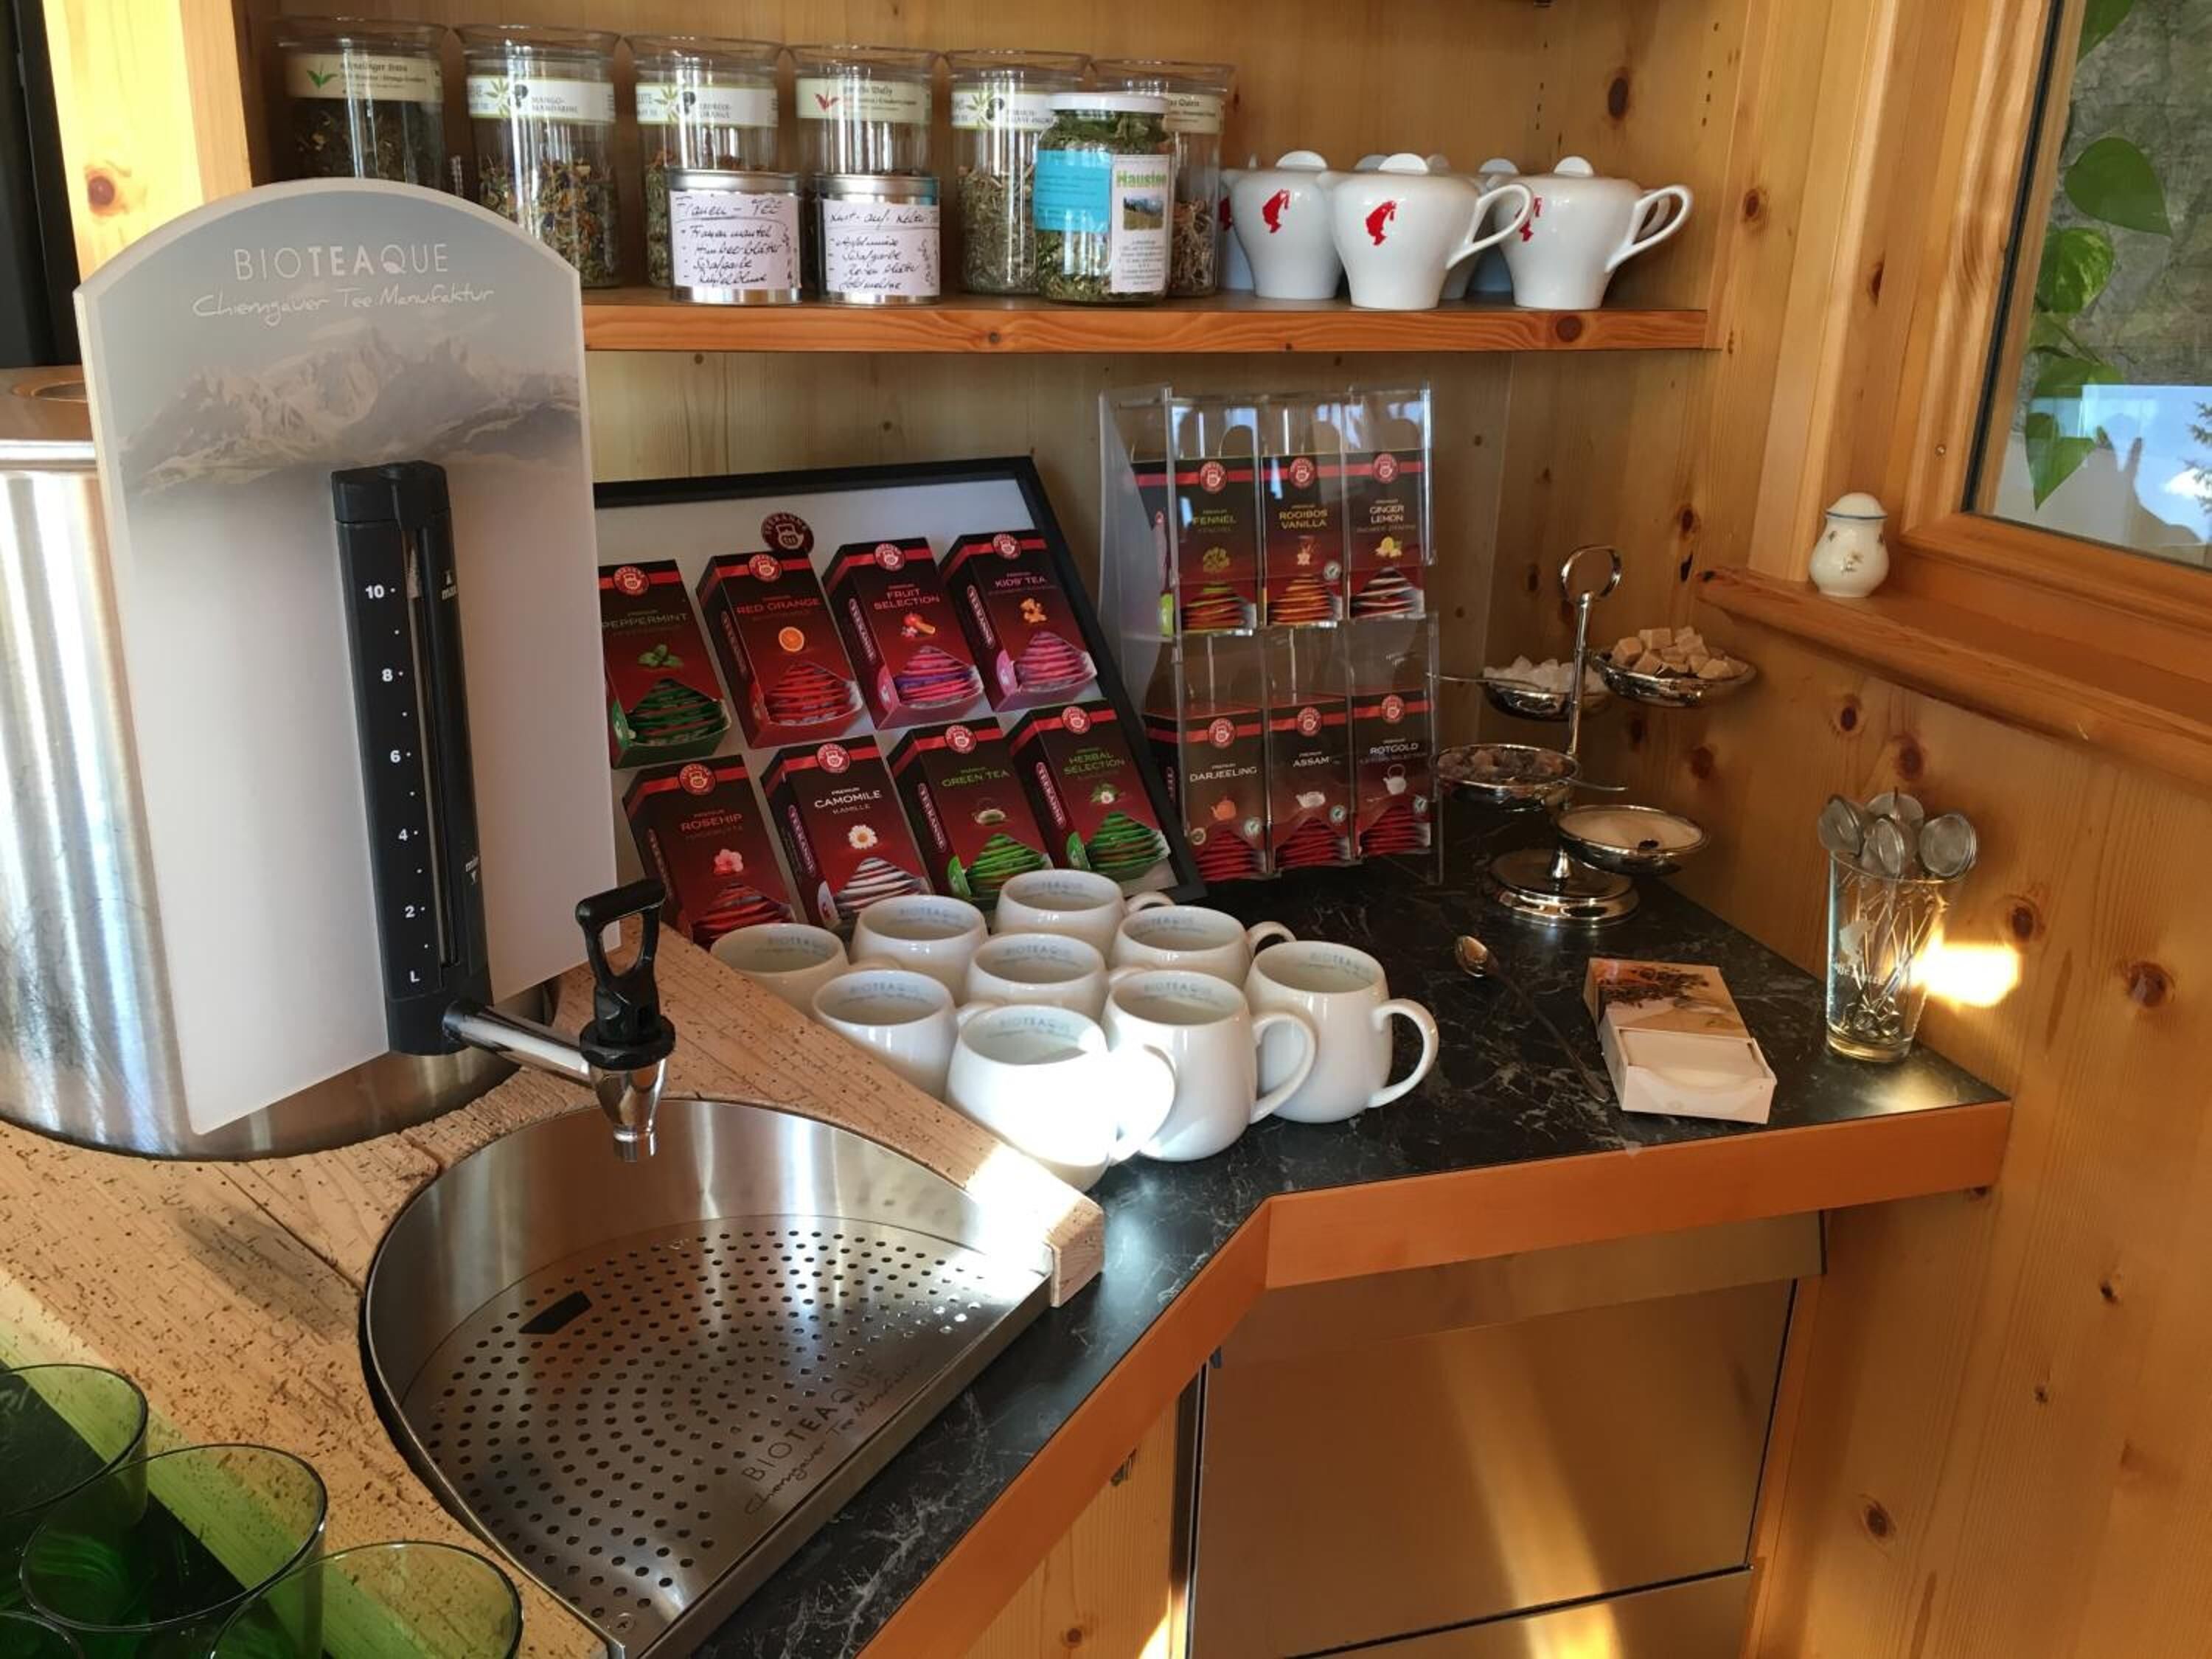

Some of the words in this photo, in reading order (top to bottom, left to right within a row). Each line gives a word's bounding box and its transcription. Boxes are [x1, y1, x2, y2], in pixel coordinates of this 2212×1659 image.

[233, 243, 448, 281] BIOTEAQUE
[333, 286, 373, 308] Tee
[378, 282, 495, 307] Manufaktur
[1279, 508, 1328, 520] ROOIBOS
[1281, 518, 1327, 529] VANILLA
[365, 584, 386, 599] 10
[886, 588, 921, 599] FRUIT
[873, 595, 941, 611] SELECTION
[381, 668, 394, 682] 8
[1369, 742, 1420, 755] ROTGOLD
[389, 749, 401, 763] 6
[1068, 751, 1115, 765] HERBAL
[1293, 755, 1330, 768] ASSAM
[1062, 759, 1126, 775] SELECTION
[1189, 765, 1257, 783] DARJEELING
[942, 773, 984, 787] GREEN
[985, 769, 1011, 779] TEA
[813, 789, 883, 809] CAMOMILE
[680, 813, 743, 832] ROSEHIP
[398, 828, 408, 841] 4
[405, 905, 417, 918] 2
[409, 970, 421, 983] L
[741, 1365, 883, 1483] BIOTEAQUE
